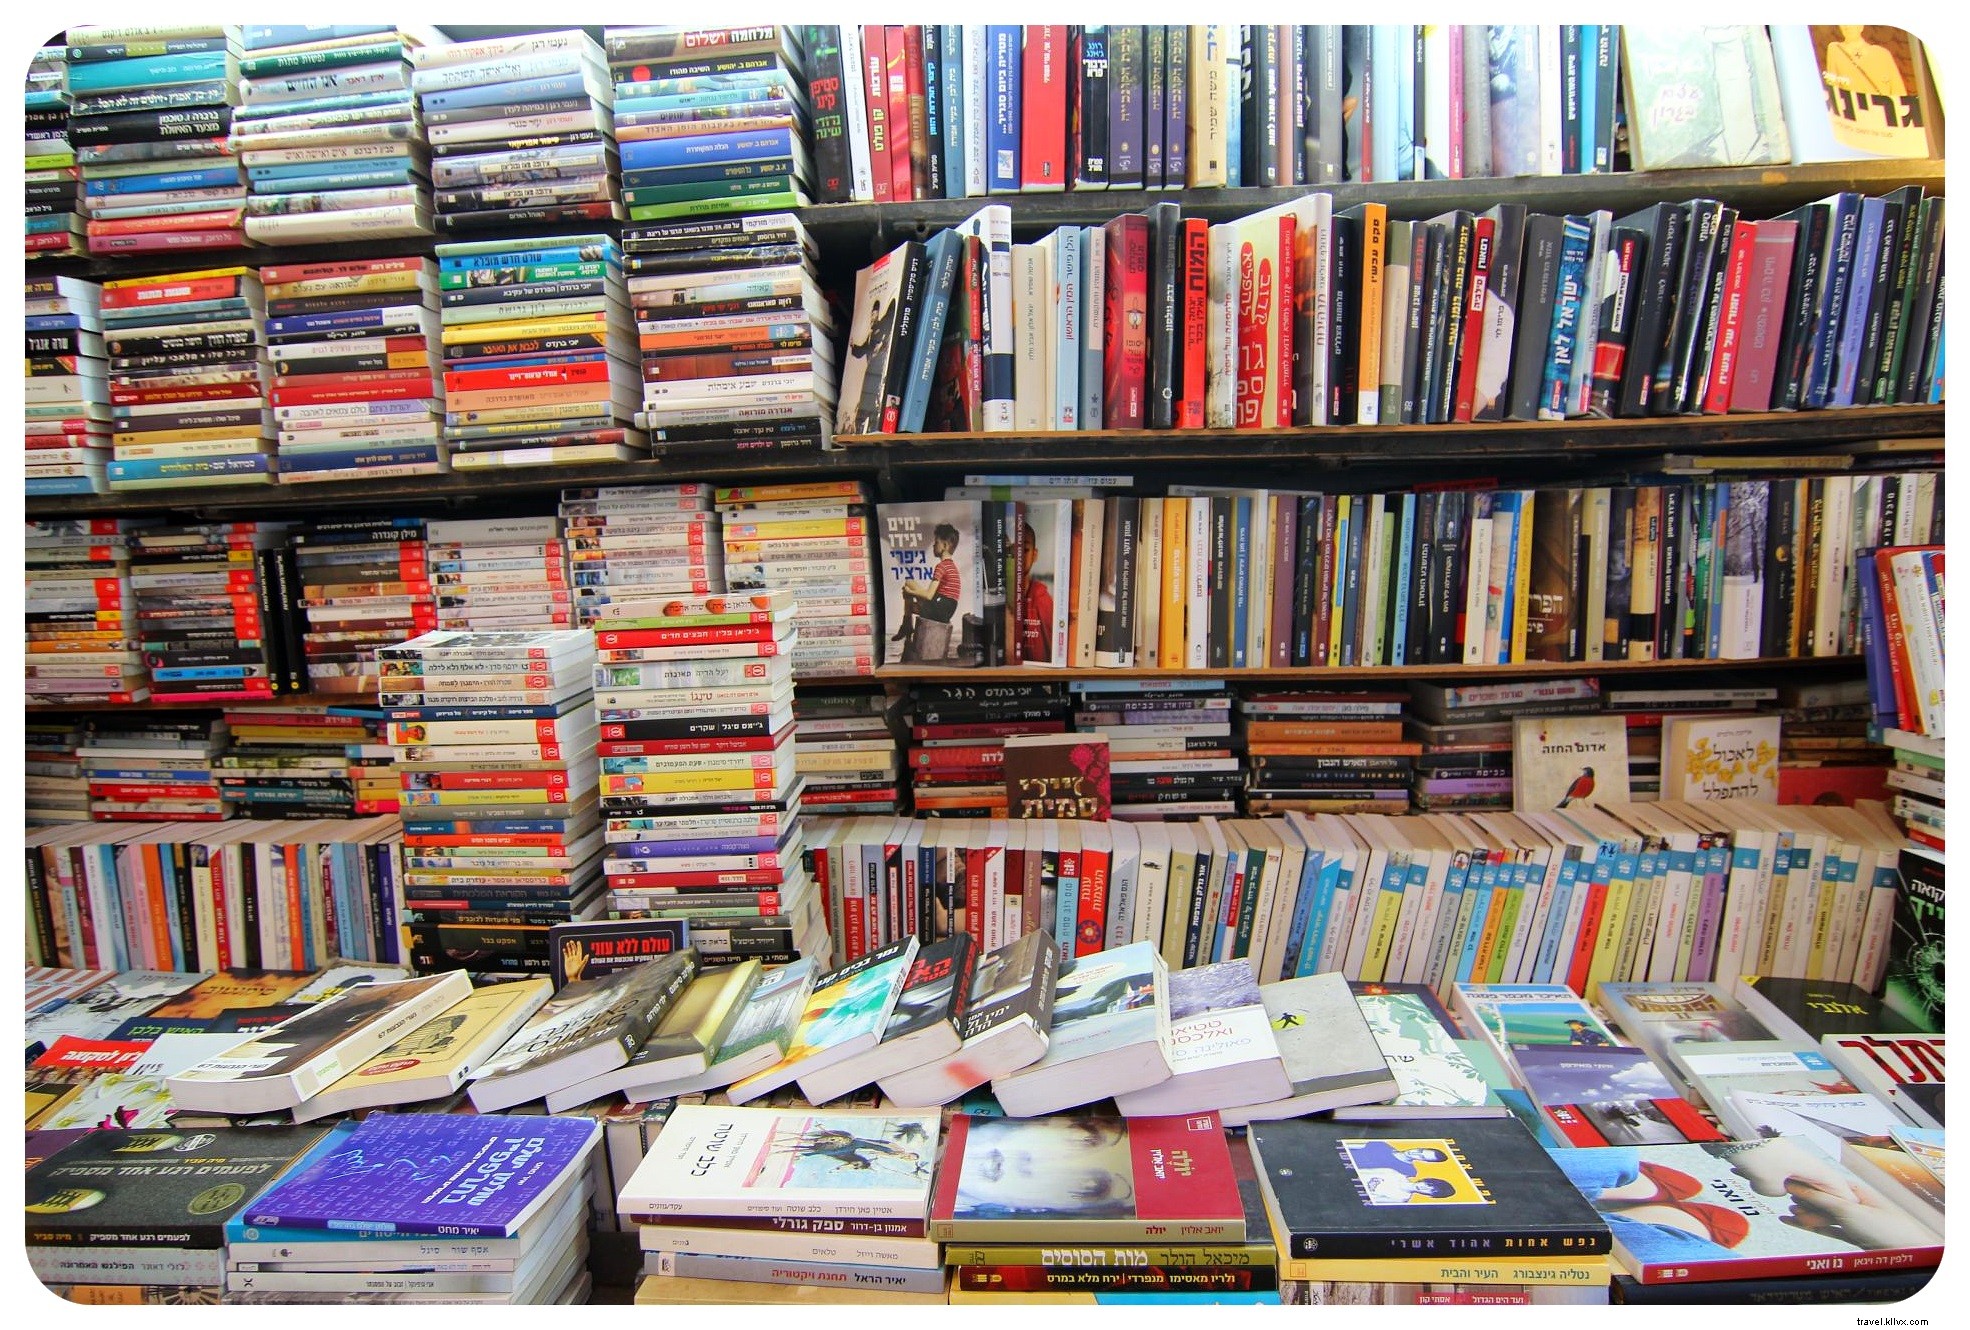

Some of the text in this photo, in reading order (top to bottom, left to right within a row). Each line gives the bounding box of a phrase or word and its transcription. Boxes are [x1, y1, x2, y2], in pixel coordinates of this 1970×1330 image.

[731, 26, 774, 42] מלחמה
[524, 253, 542, 263] עולם
[1188, 232, 1204, 291] המוח
[1065, 254, 1073, 279] פישר
[1065, 306, 1074, 340] הראשון
[1554, 275, 1579, 364] ישראל לאן
[887, 517, 921, 531] ימים
[888, 532, 922, 549] יגידו
[1542, 742, 1607, 754] אדום החזה
[1713, 742, 1756, 761] לאכול
[1703, 783, 1759, 800] להתפלל
[1080, 876, 1091, 901] עונת
[1092, 869, 1103, 912] העצמות
[616, 939, 639, 954] ללא
[641, 938, 670, 953] עולם
[1171, 1018, 1222, 1035] טטיא
[438, 1225, 460, 1235] מחט
[772, 1218, 808, 1230] גורלי
[812, 1220, 844, 1233] ספק
[1145, 1226, 1166, 1235] יולה
[1504, 1238, 1549, 1247] אחות
[1563, 1238, 1596, 1247] נפש
[1041, 1248, 1105, 1266] הסוסים
[1114, 1248, 1148, 1266] מות
[1202, 1249, 1250, 1265] מיכאל
[1875, 1256, 1889, 1264] דה
[1047, 1271, 1236, 1284] ולריו מאסימו מנפרדי ירח מלא במרס
[1441, 1267, 1471, 1277] והבית
[1474, 1267, 1499, 1277] העיר
[1559, 1267, 1590, 1280] נטליה
